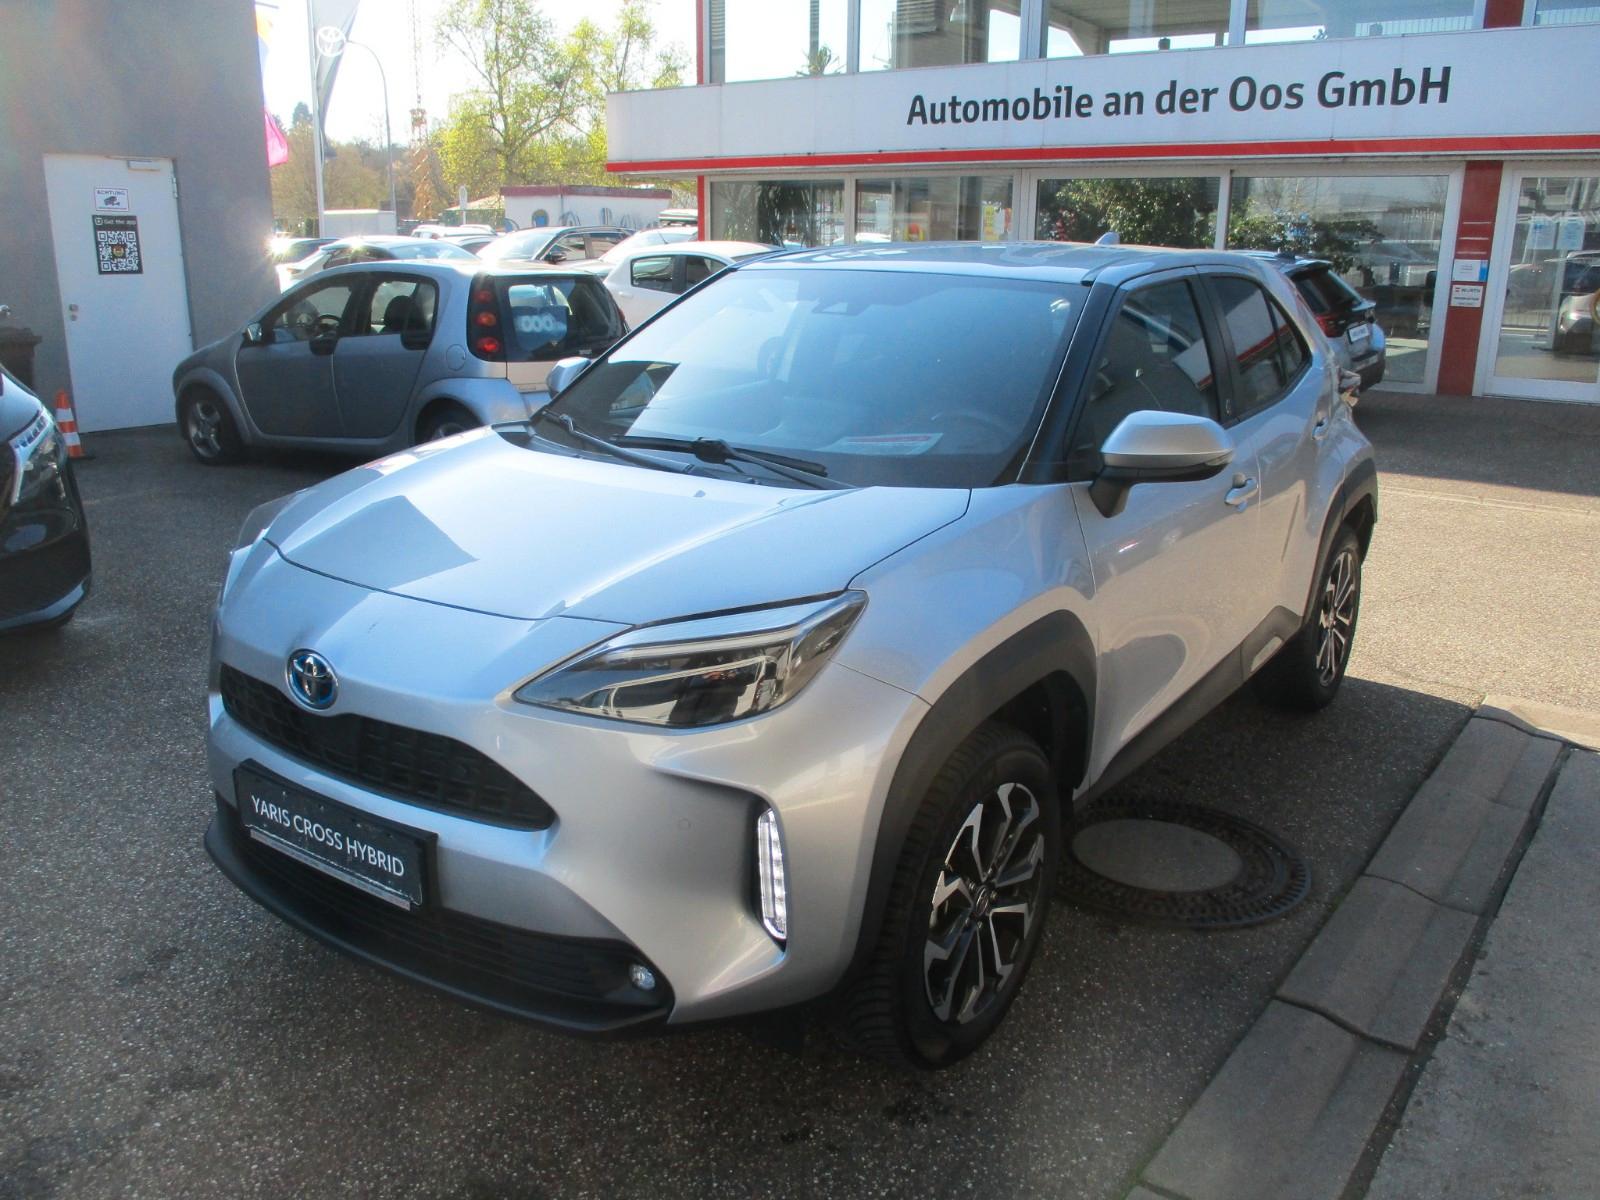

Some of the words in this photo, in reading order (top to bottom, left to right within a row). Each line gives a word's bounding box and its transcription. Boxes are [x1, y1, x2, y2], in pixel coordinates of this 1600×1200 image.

[907, 85, 1093, 125] Automobile
[1103, 90, 1144, 117] an
[1155, 80, 1219, 115] der
[1229, 76, 1304, 112] Oos
[1317, 66, 1452, 108] GmbH
[252, 795, 290, 827] YARIS
[293, 815, 343, 850] CROSS
[346, 837, 405, 877] HYBRID
